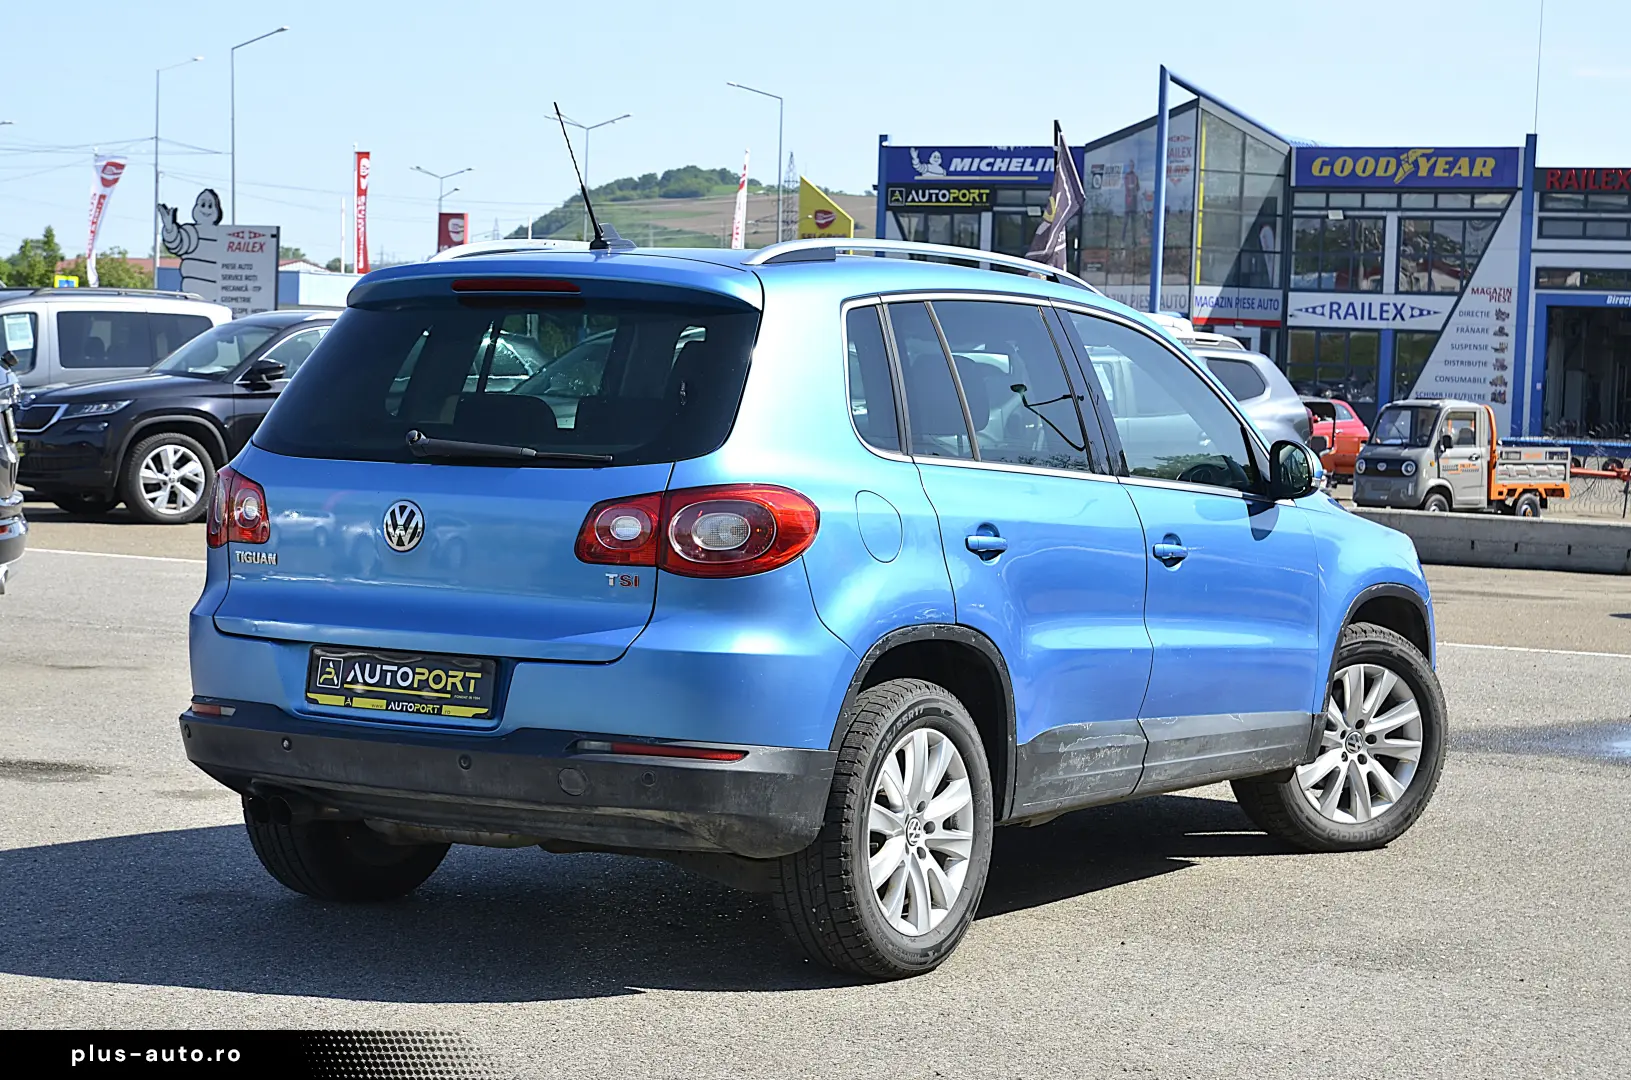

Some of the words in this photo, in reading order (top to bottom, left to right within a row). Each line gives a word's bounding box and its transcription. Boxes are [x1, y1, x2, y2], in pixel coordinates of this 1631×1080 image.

[1545, 168, 1631, 191] RAILEX
[907, 189, 990, 203] AUTOPORT
[226, 241, 266, 253] RAILEX
[1471, 286, 1512, 297] MAGAZIN
[1489, 294, 1512, 303] PIESE
[1131, 294, 1150, 309] PIES
[1160, 294, 1187, 309] AUTO
[1194, 296, 1233, 309] MAGAZIN
[1234, 297, 1256, 310] PIESE
[1258, 298, 1280, 311] AUTO
[1329, 302, 1406, 322] RAILEX
[1450, 343, 1489, 351] SUSPENSIE
[1434, 375, 1487, 384] CONSUMABILE
[235, 550, 278, 566] TIGUAN
[605, 572, 640, 588] TSI
[346, 661, 482, 693] AUTOPORT
[388, 701, 440, 714] AUTOPORT
